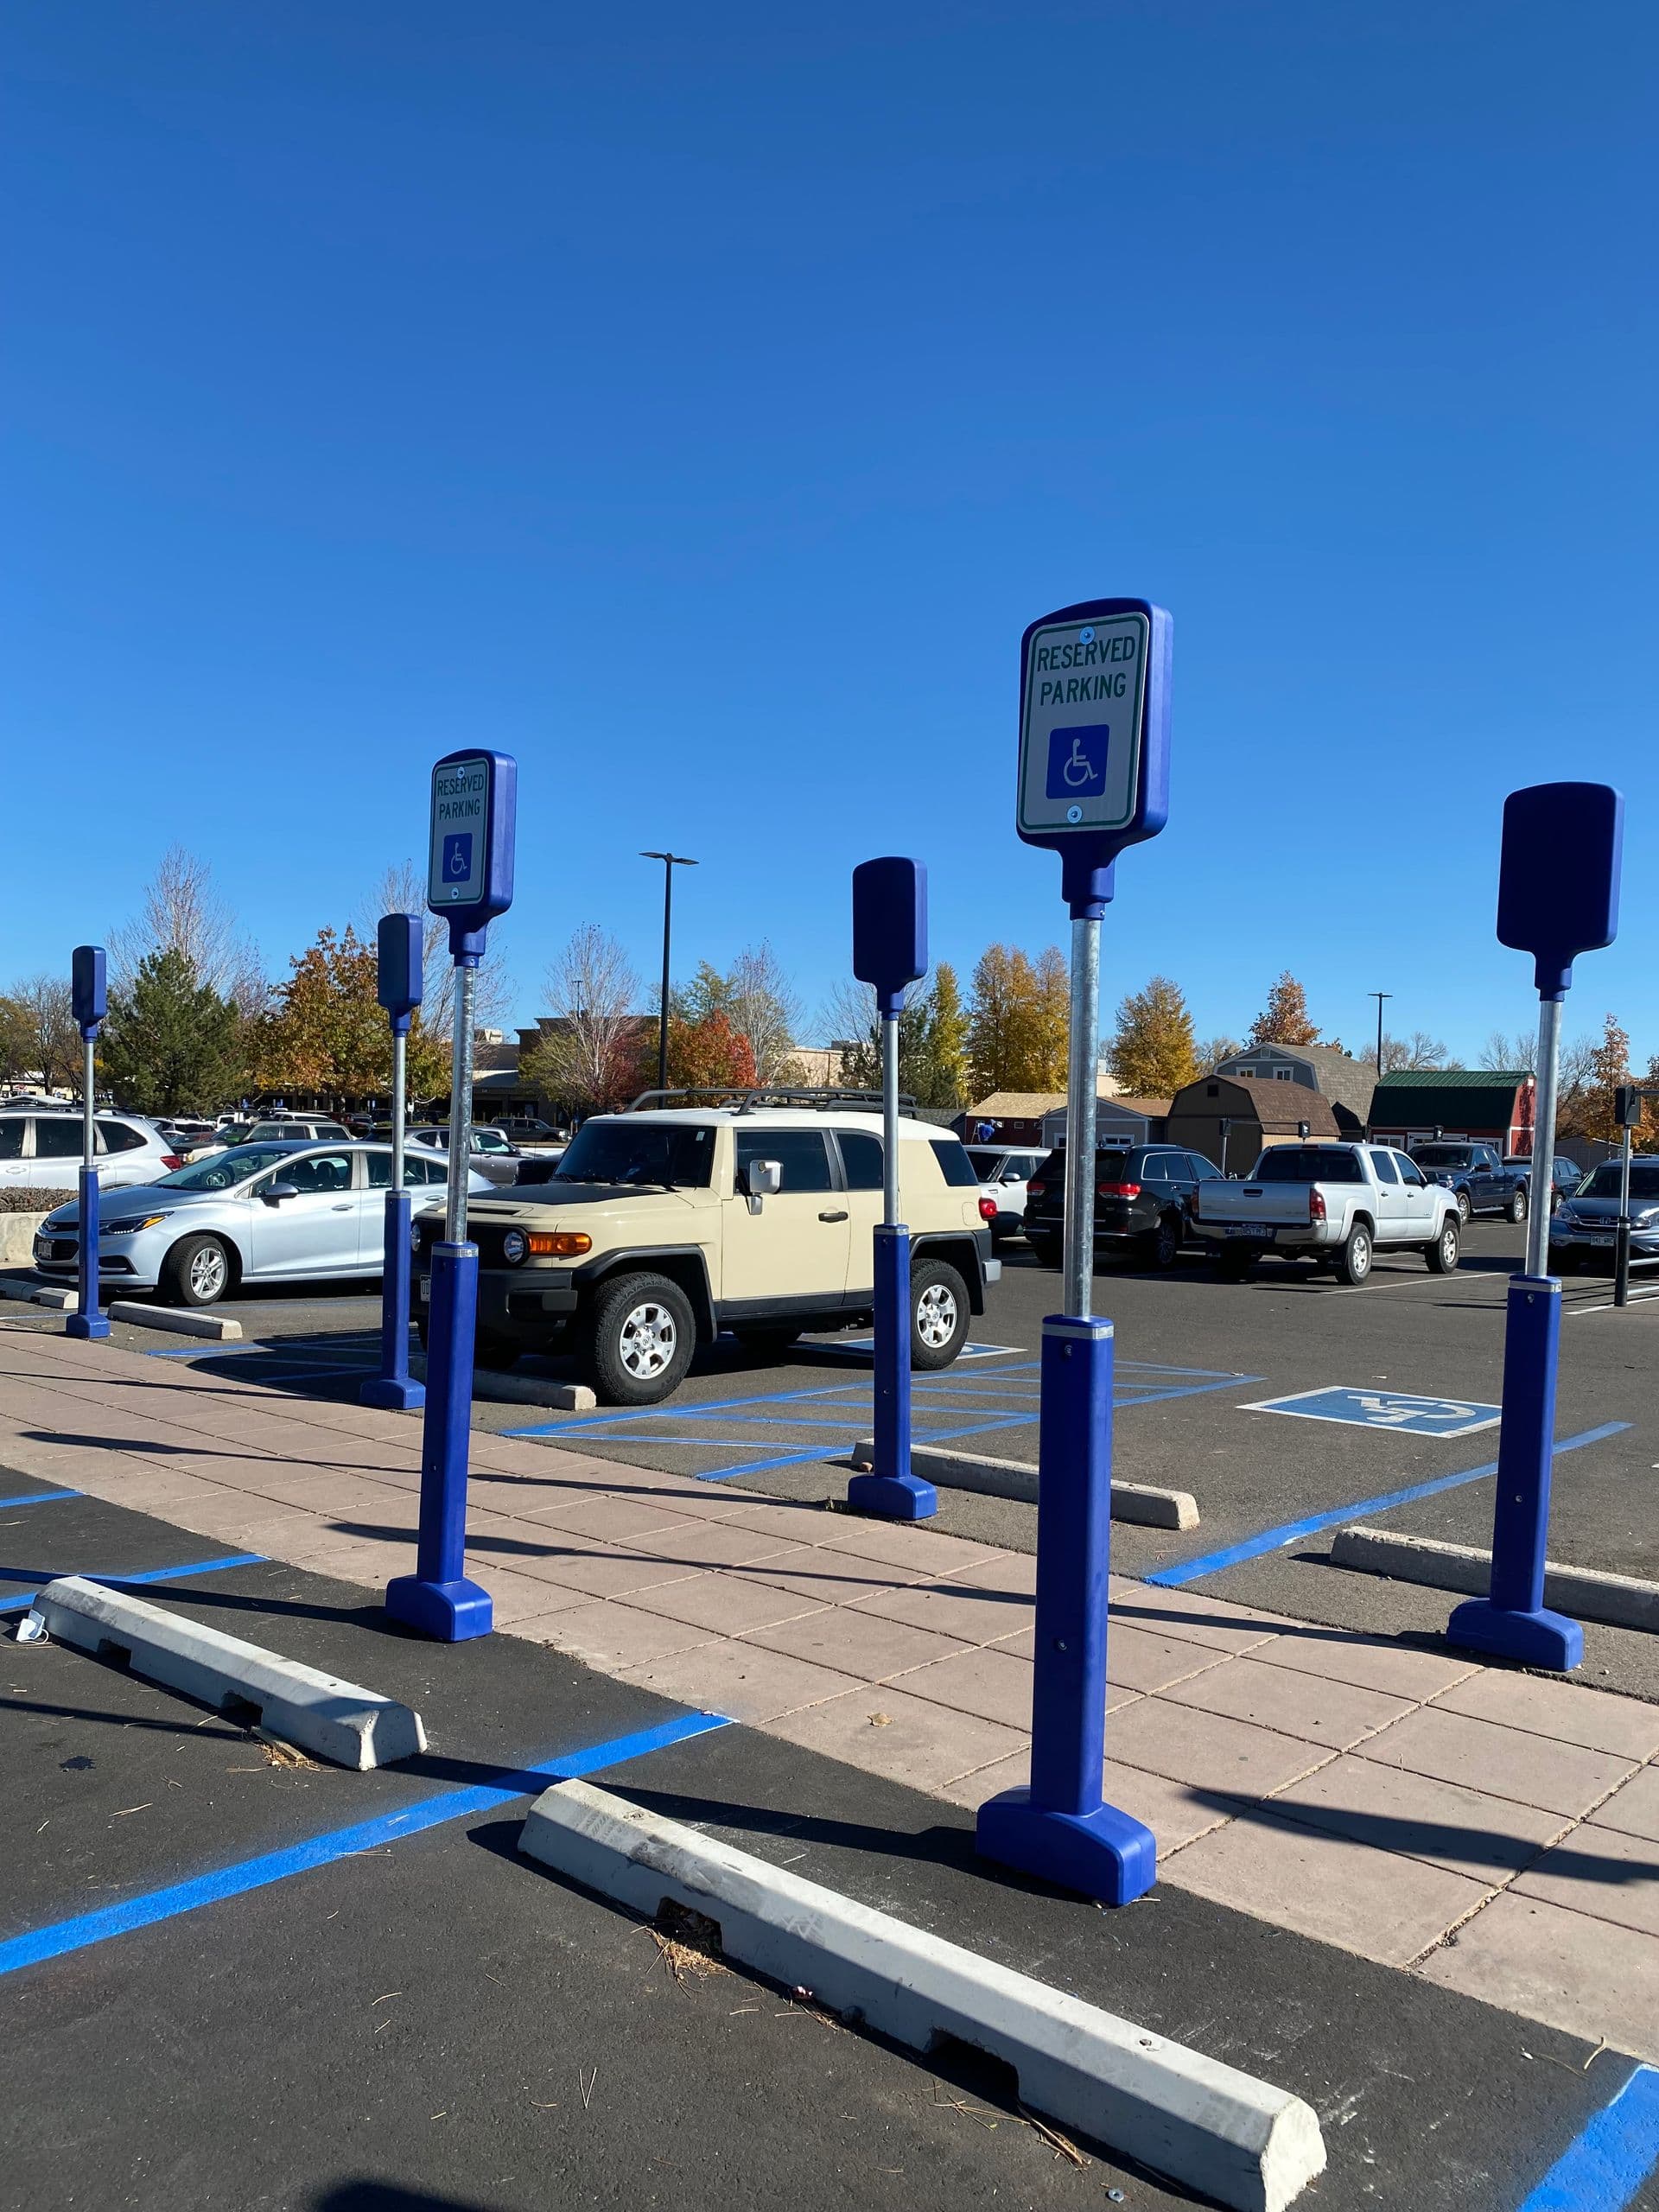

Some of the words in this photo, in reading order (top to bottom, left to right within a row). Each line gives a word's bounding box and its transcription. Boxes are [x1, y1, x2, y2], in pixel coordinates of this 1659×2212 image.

[1037, 636, 1135, 671] RESERVED
[1040, 672, 1126, 706] PARKING
[437, 774, 484, 796] RESERVED
[439, 798, 480, 820] PARKING
